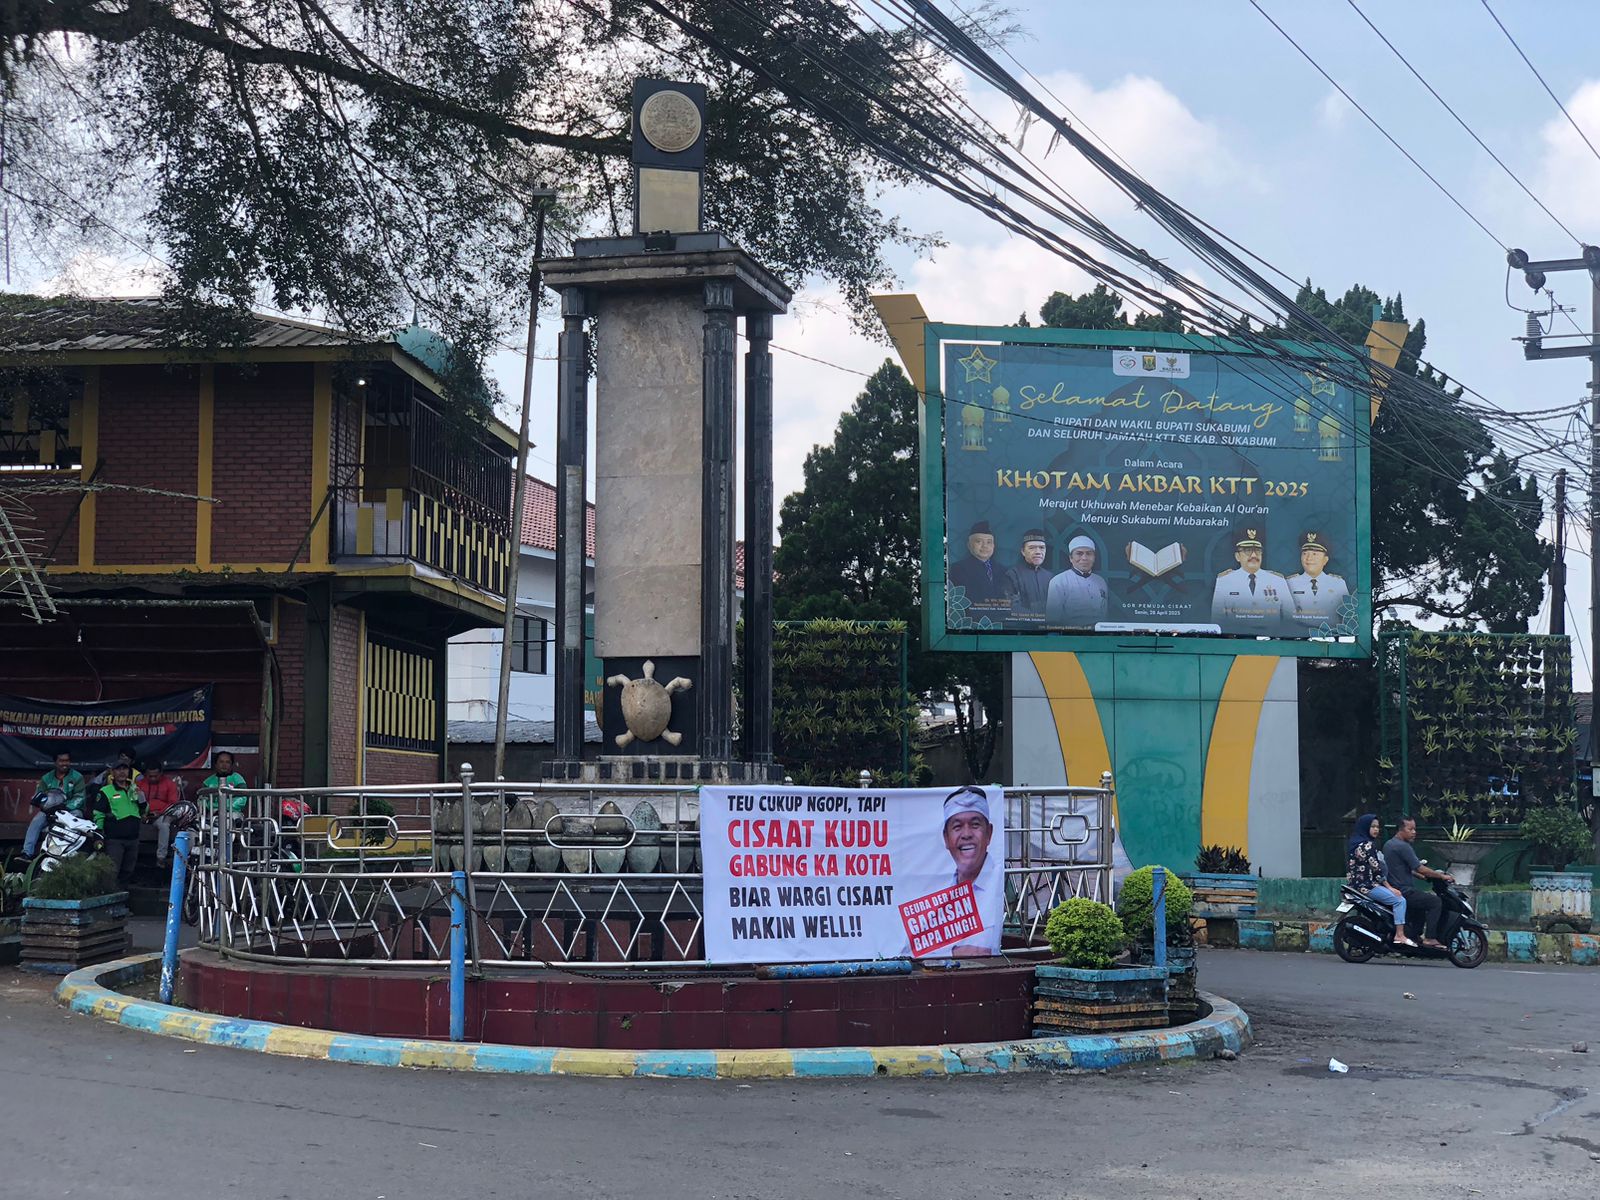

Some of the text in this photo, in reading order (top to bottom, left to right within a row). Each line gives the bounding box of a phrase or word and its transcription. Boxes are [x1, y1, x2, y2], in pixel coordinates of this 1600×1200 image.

[1019, 382, 1283, 428] Selamat Datang
[1053, 416, 1251, 433] BUPATI DAN WAKIL BUPATI SUKABUMI
[1028, 428, 1051, 438] DAN
[1053, 430, 1103, 440] SELURUH
[1155, 432, 1177, 443] KTT
[1178, 434, 1192, 444] SE
[1193, 434, 1218, 445] KAB.
[1221, 436, 1277, 446] SUKABUMI
[1124, 458, 1183, 469] Dalam Acara
[996, 467, 1309, 497] KHOTAM AKBAR KTT 2025
[1039, 498, 1079, 510] Merajut
[1081, 499, 1127, 511] Ukhuwah
[1129, 501, 1174, 512] Menebar
[1176, 502, 1222, 513] Kebaikan
[1224, 503, 1235, 513] Al
[1081, 514, 1229, 527] Menuju Sukabumi Mubarakah
[42, 715, 85, 727] PELOPOR
[85, 712, 149, 728] KESELAMATAN
[151, 709, 205, 724] LALULINTAS
[44, 727, 57, 736] SAT
[57, 728, 83, 737] LANTAS
[84, 729, 109, 738] POLRES
[109, 727, 146, 737] SUKABUMI
[148, 726, 165, 736] KOTA
[727, 795, 887, 815] TEU CUKUP NGOPI, TAPI
[727, 819, 888, 848] CISAAT KUDU
[729, 853, 893, 877] GABUNG KA KOTA
[729, 885, 893, 908] BIAR WARGI CISAAT
[903, 884, 969, 917] GEURA DER KEUN
[731, 915, 863, 940] MAKIN WELL!!
[907, 896, 974, 936] GAGASAN
[913, 915, 978, 952] BAPA AING!!
